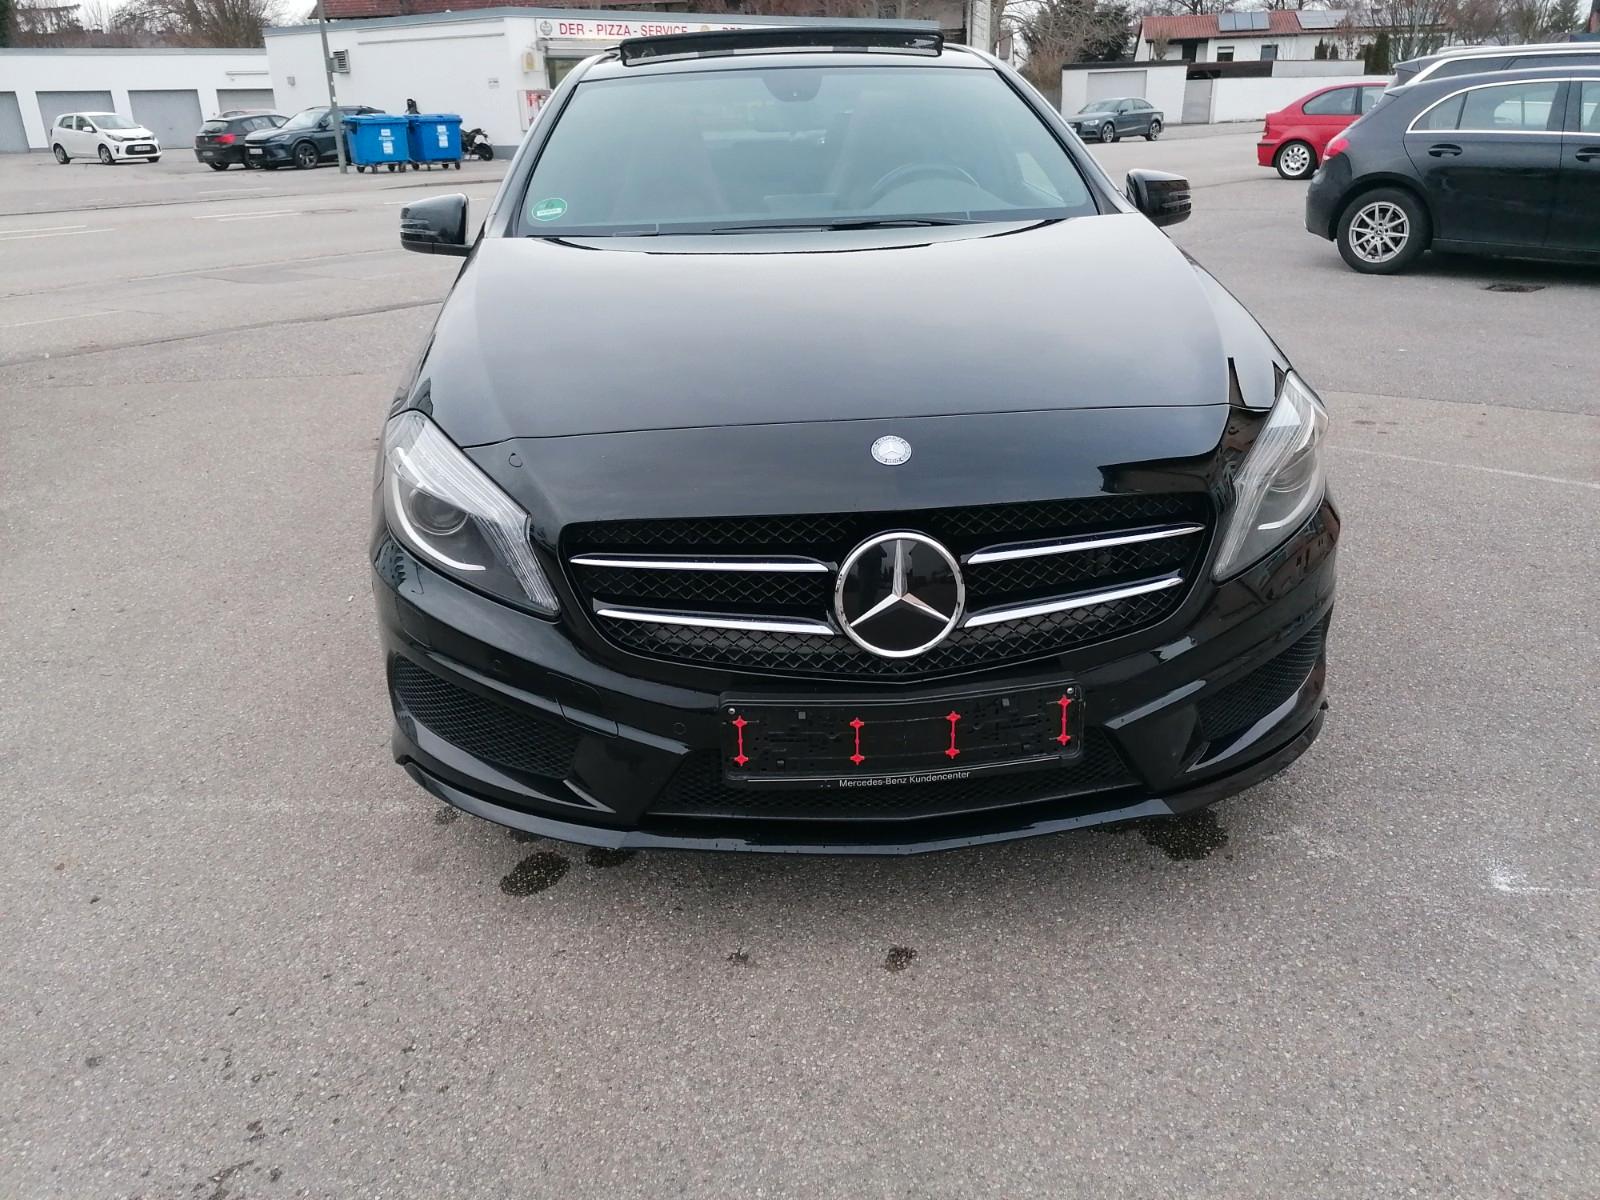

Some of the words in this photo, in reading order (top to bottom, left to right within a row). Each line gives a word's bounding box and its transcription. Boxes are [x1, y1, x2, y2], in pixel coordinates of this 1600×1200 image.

[559, 23, 585, 35] DER
[597, 24, 631, 36] PIZZA
[840, 777, 908, 787] Mercedes-Benz
[909, 771, 970, 783] Kundencenter
